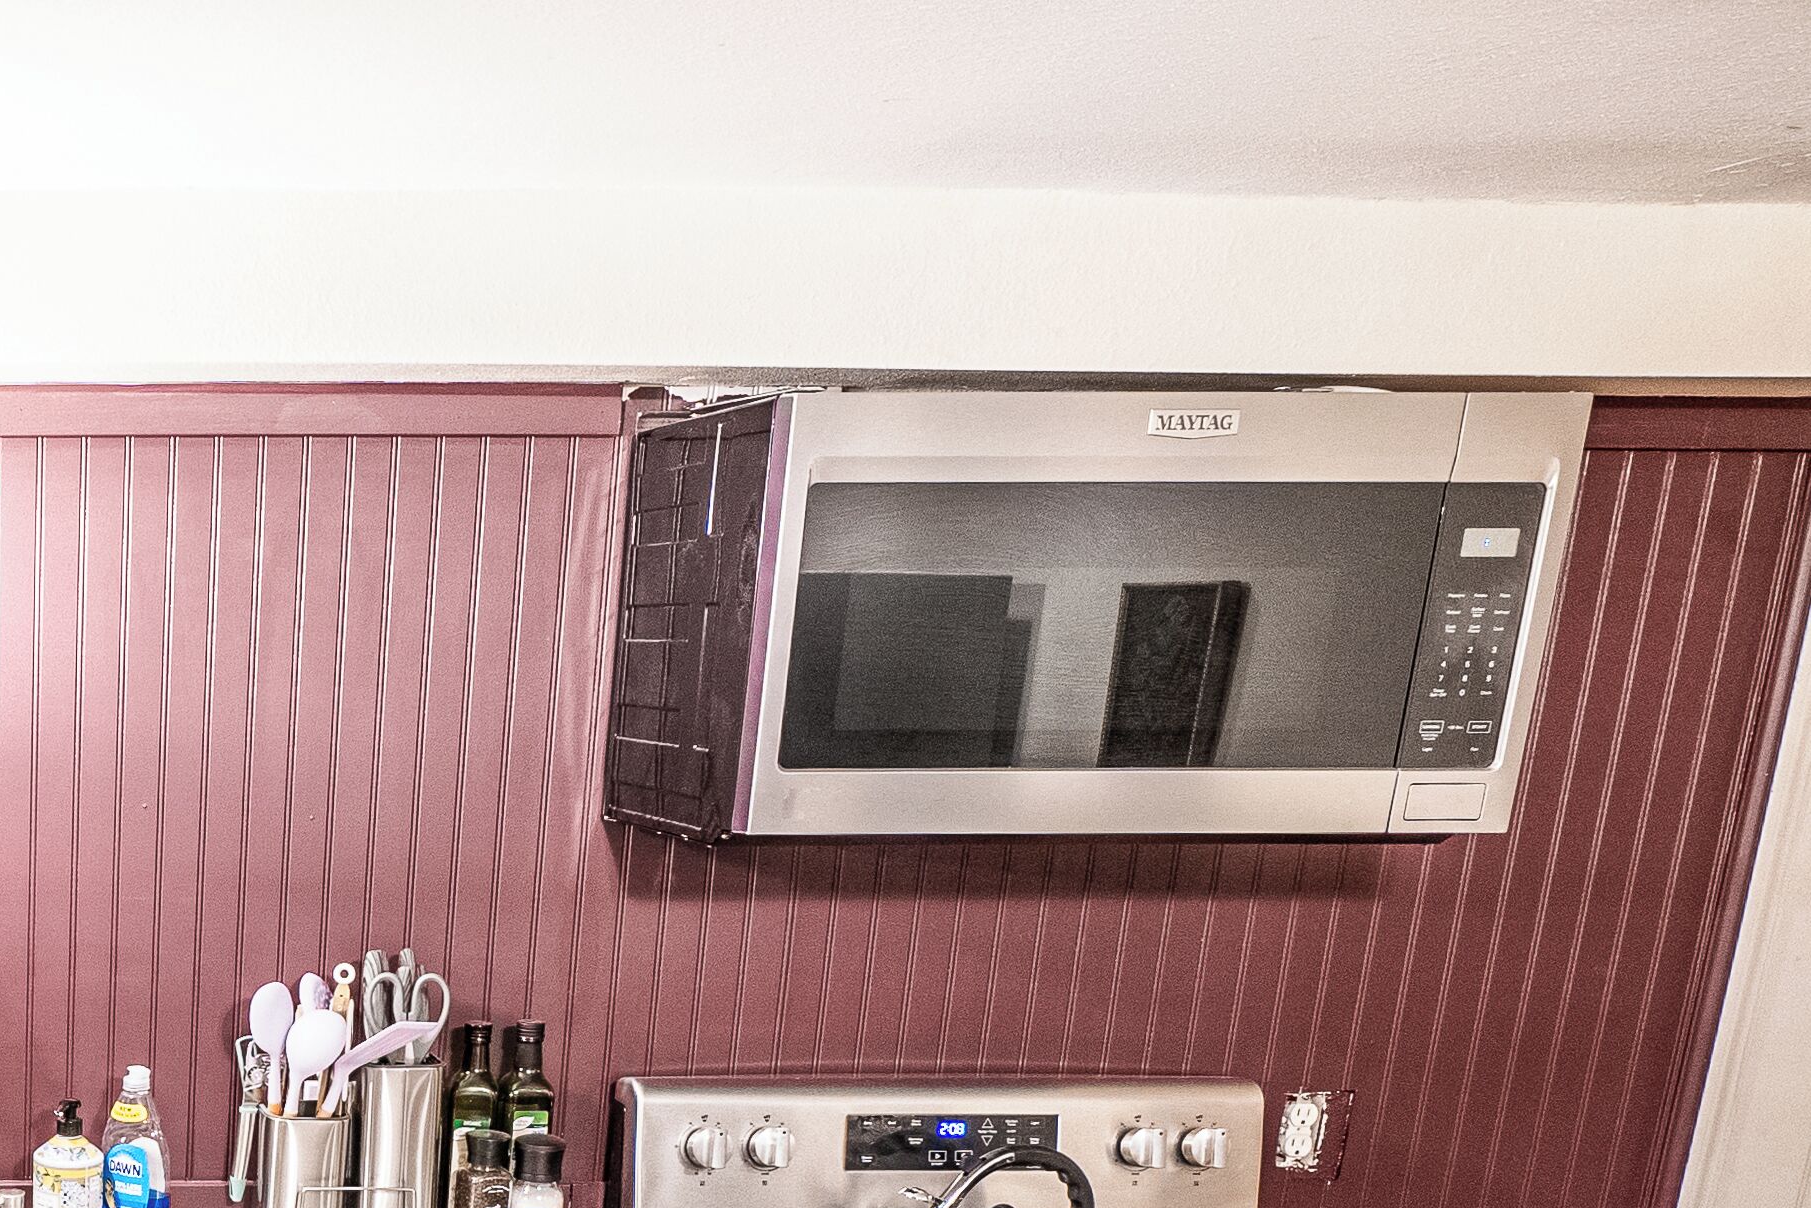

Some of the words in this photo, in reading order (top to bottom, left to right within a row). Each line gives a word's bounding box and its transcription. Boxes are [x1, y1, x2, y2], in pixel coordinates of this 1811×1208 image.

[1155, 414, 1234, 431] MAYTAG
[939, 1122, 965, 1136] 2:08
[109, 1159, 142, 1177] DAWN
